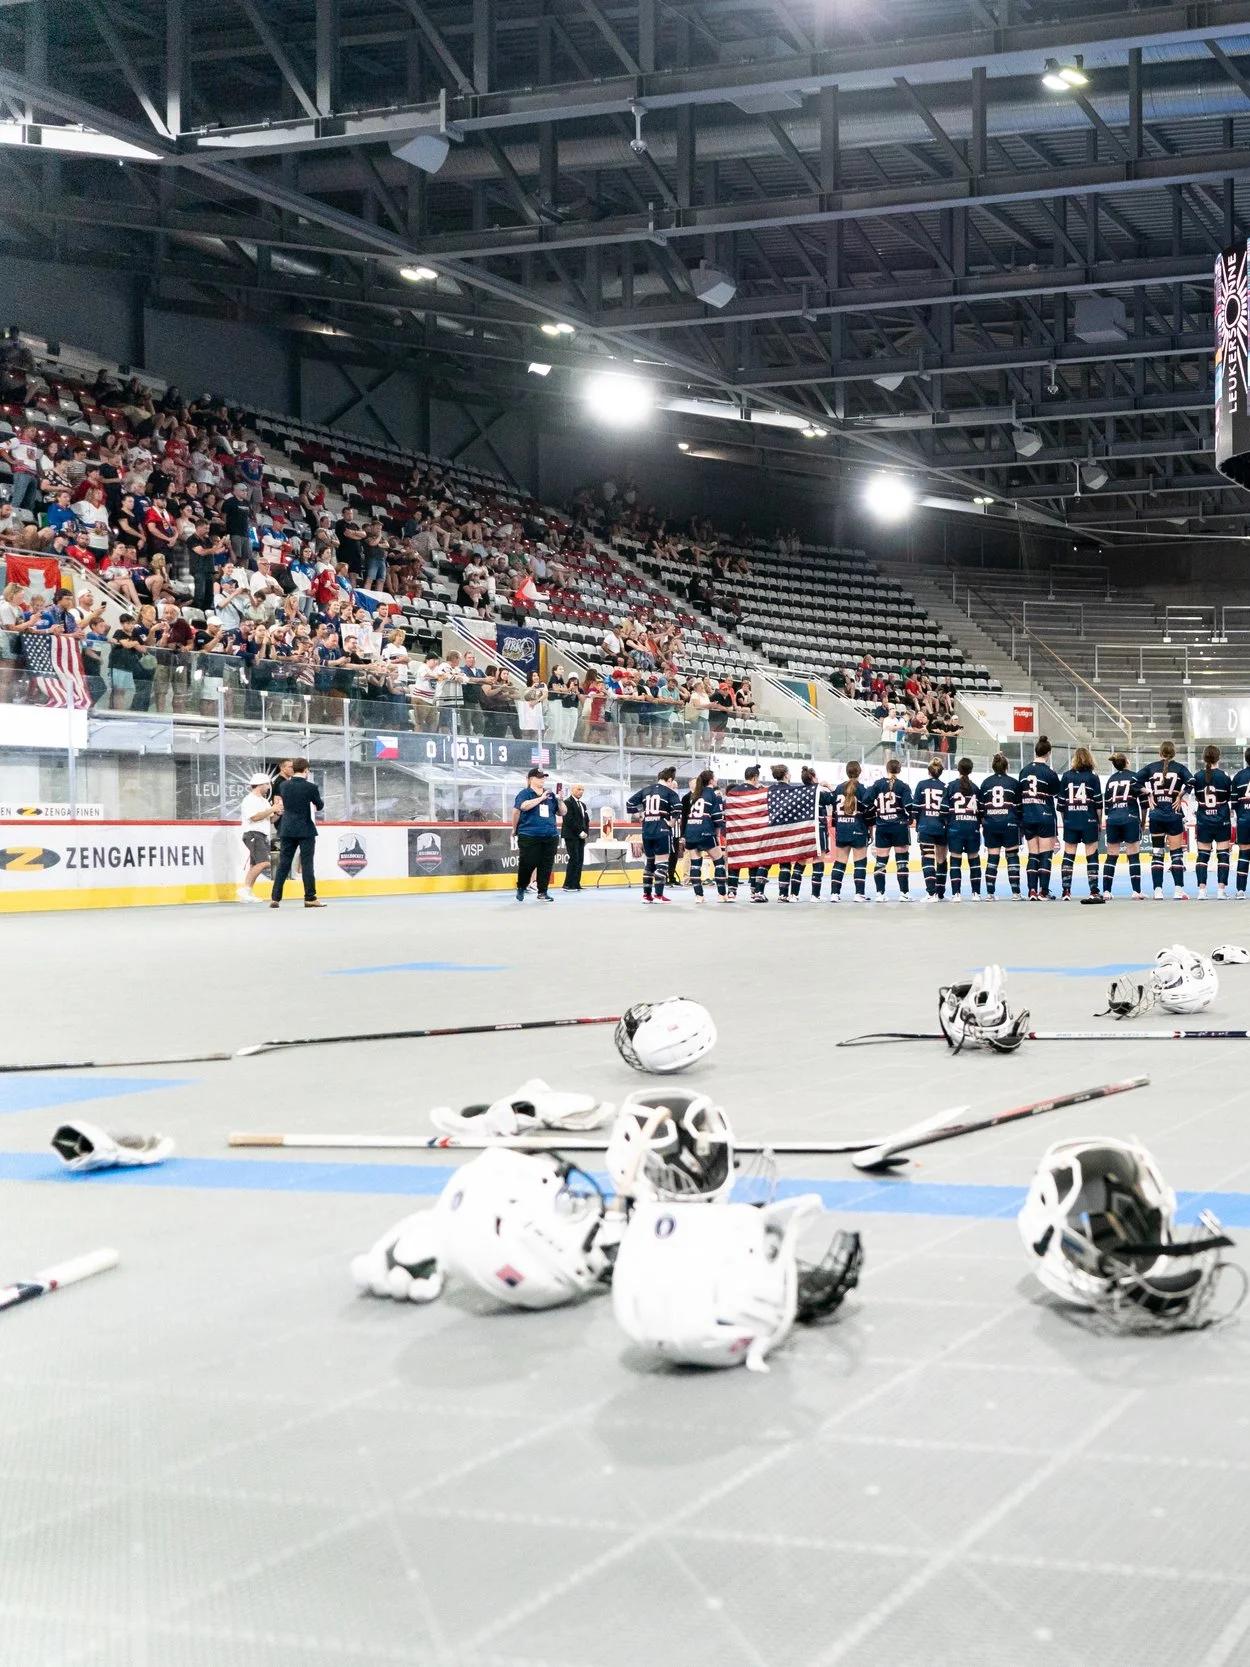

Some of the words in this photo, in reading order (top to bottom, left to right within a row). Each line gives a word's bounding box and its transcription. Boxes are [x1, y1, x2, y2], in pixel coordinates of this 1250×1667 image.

[426, 741, 436, 758] 0
[499, 746, 507, 761] 3
[1028, 774, 1038, 797] 3
[1068, 782, 1088, 804] 14
[1109, 780, 1131, 802] 77
[1153, 772, 1178, 795] 27
[646, 794, 660, 815] 10
[878, 791, 897, 814] 12
[925, 788, 943, 810] 15
[953, 792, 978, 814] 24
[992, 786, 1004, 807] 8
[1205, 786, 1217, 808] 6
[45, 807, 100, 817] ZENGAFINEN
[66, 846, 204, 868] ZENGAFFINEN
[461, 844, 484, 857] VISP
